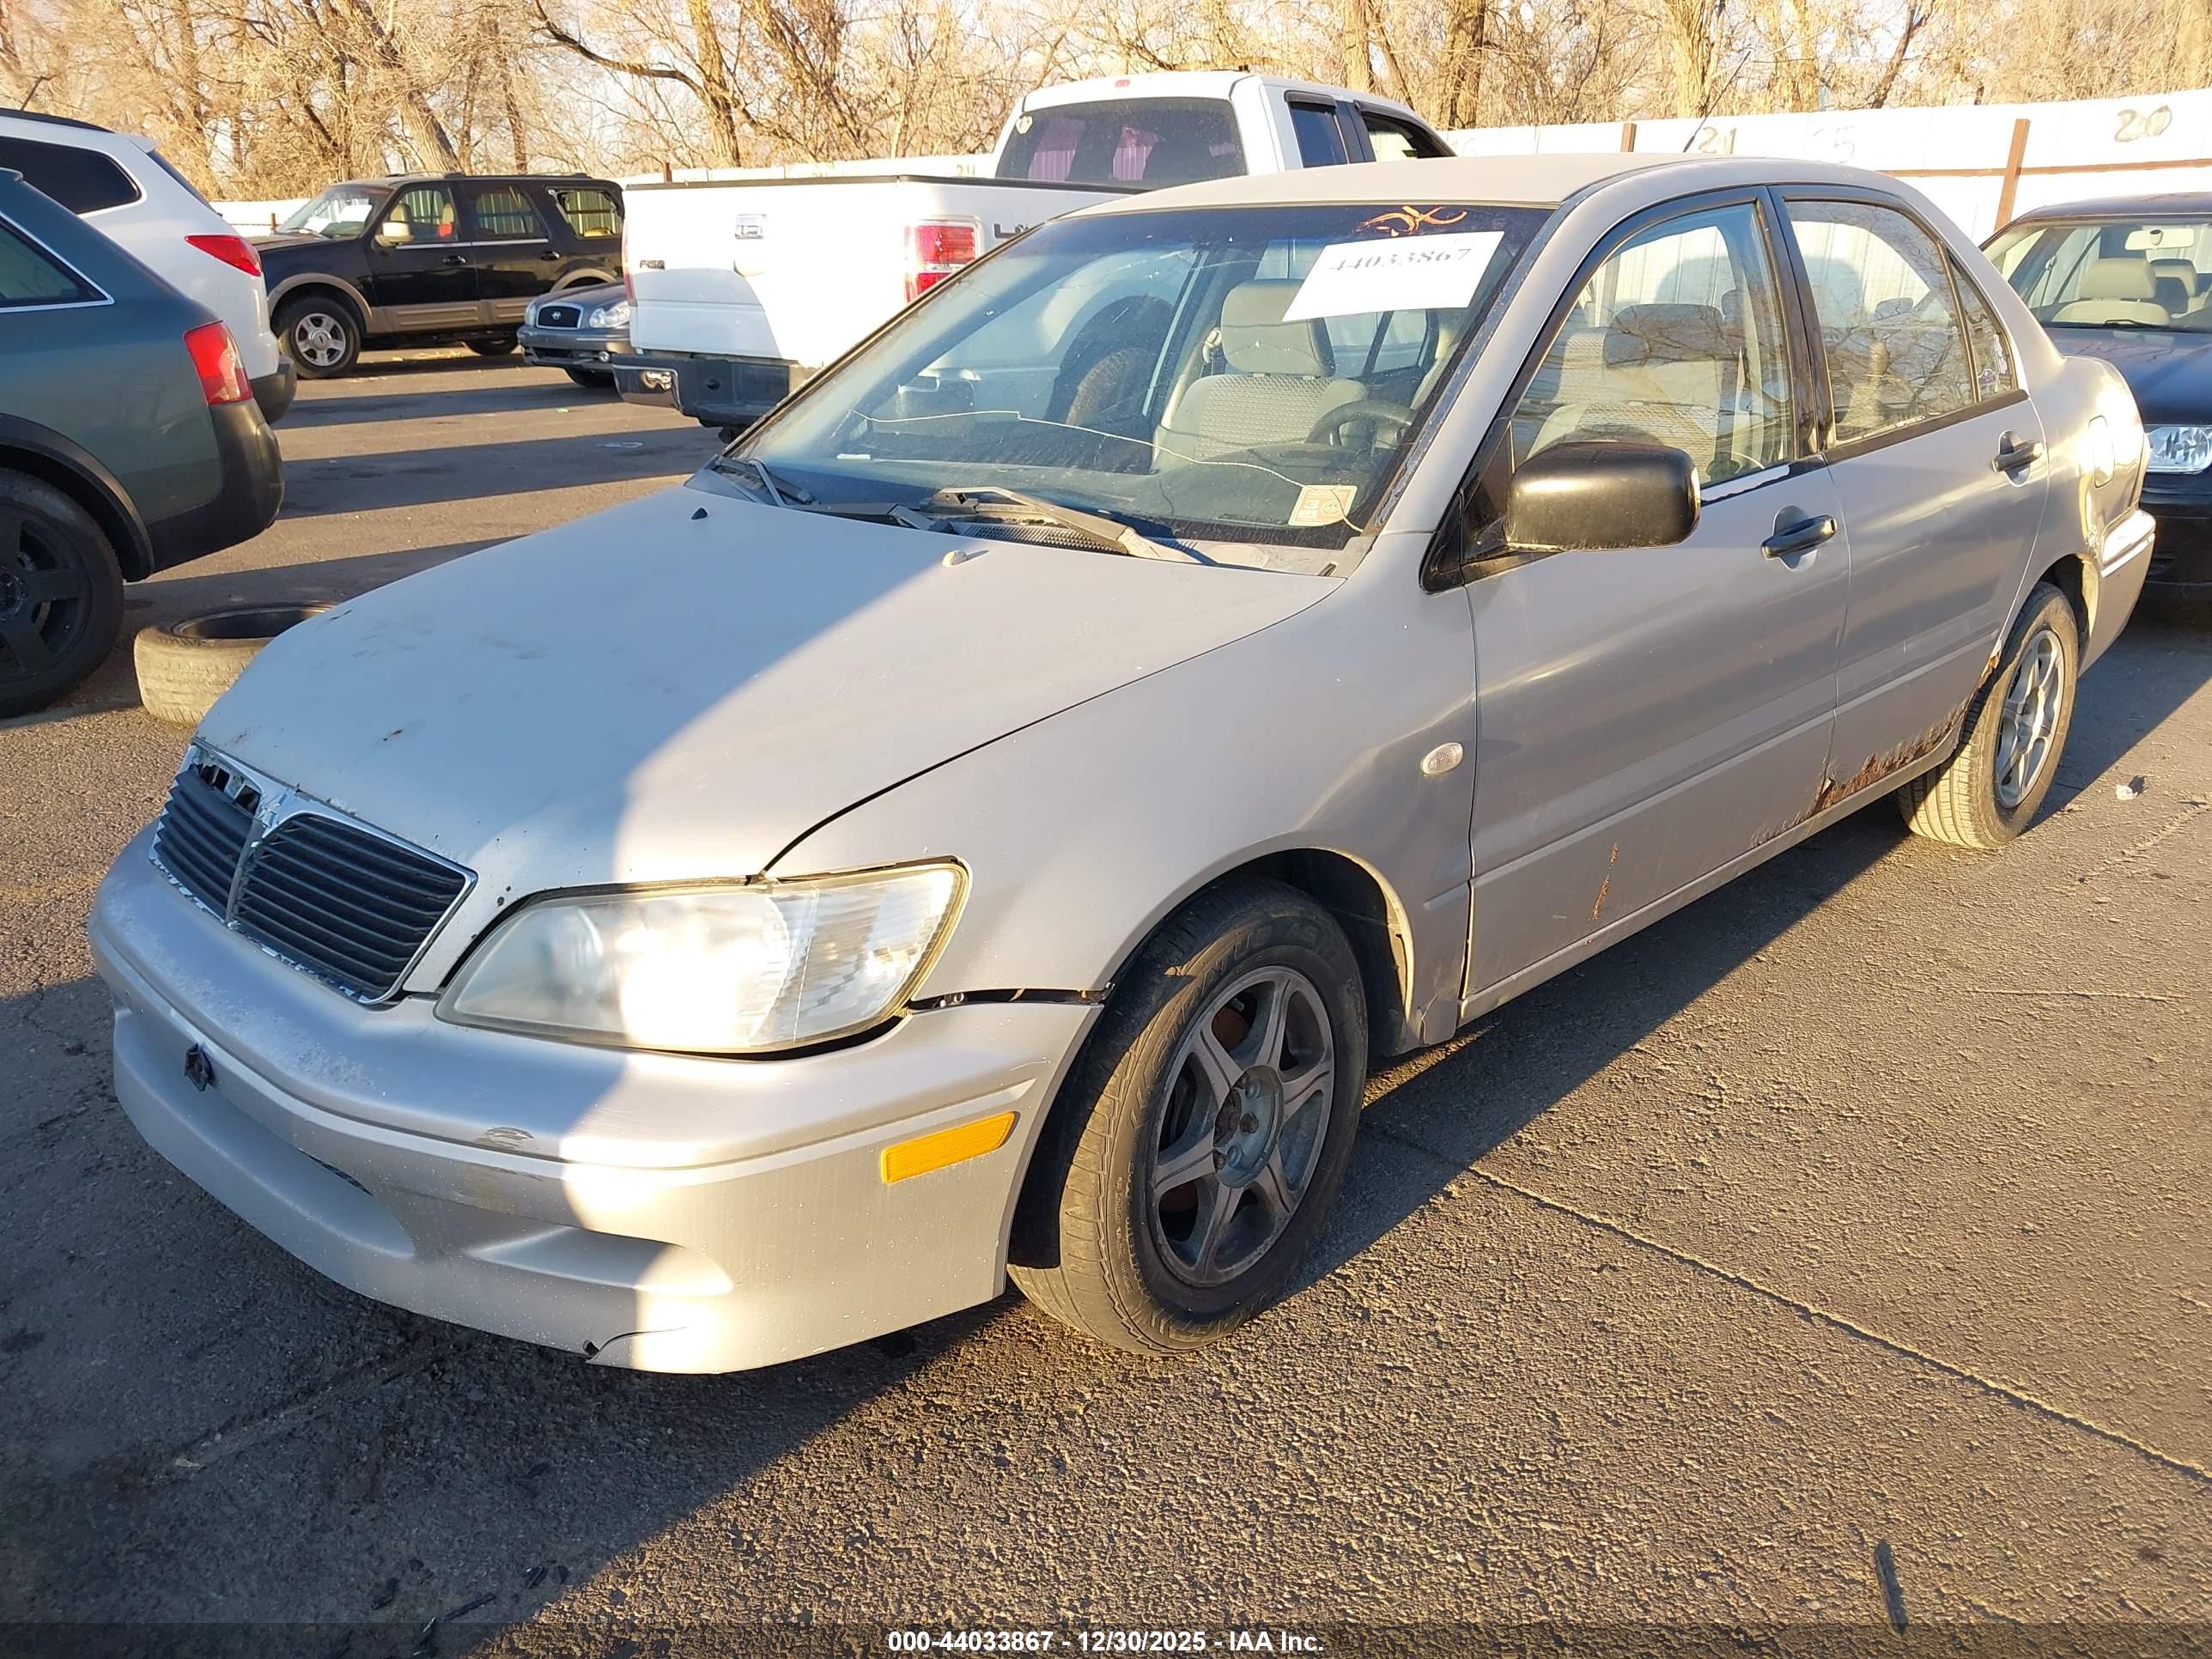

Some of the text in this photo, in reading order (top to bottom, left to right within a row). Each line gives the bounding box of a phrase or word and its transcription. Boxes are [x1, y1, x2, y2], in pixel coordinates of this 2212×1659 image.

[2113, 105, 2173, 143] 20
[1698, 126, 1737, 155] 21
[1330, 248, 1472, 271] 44033867
